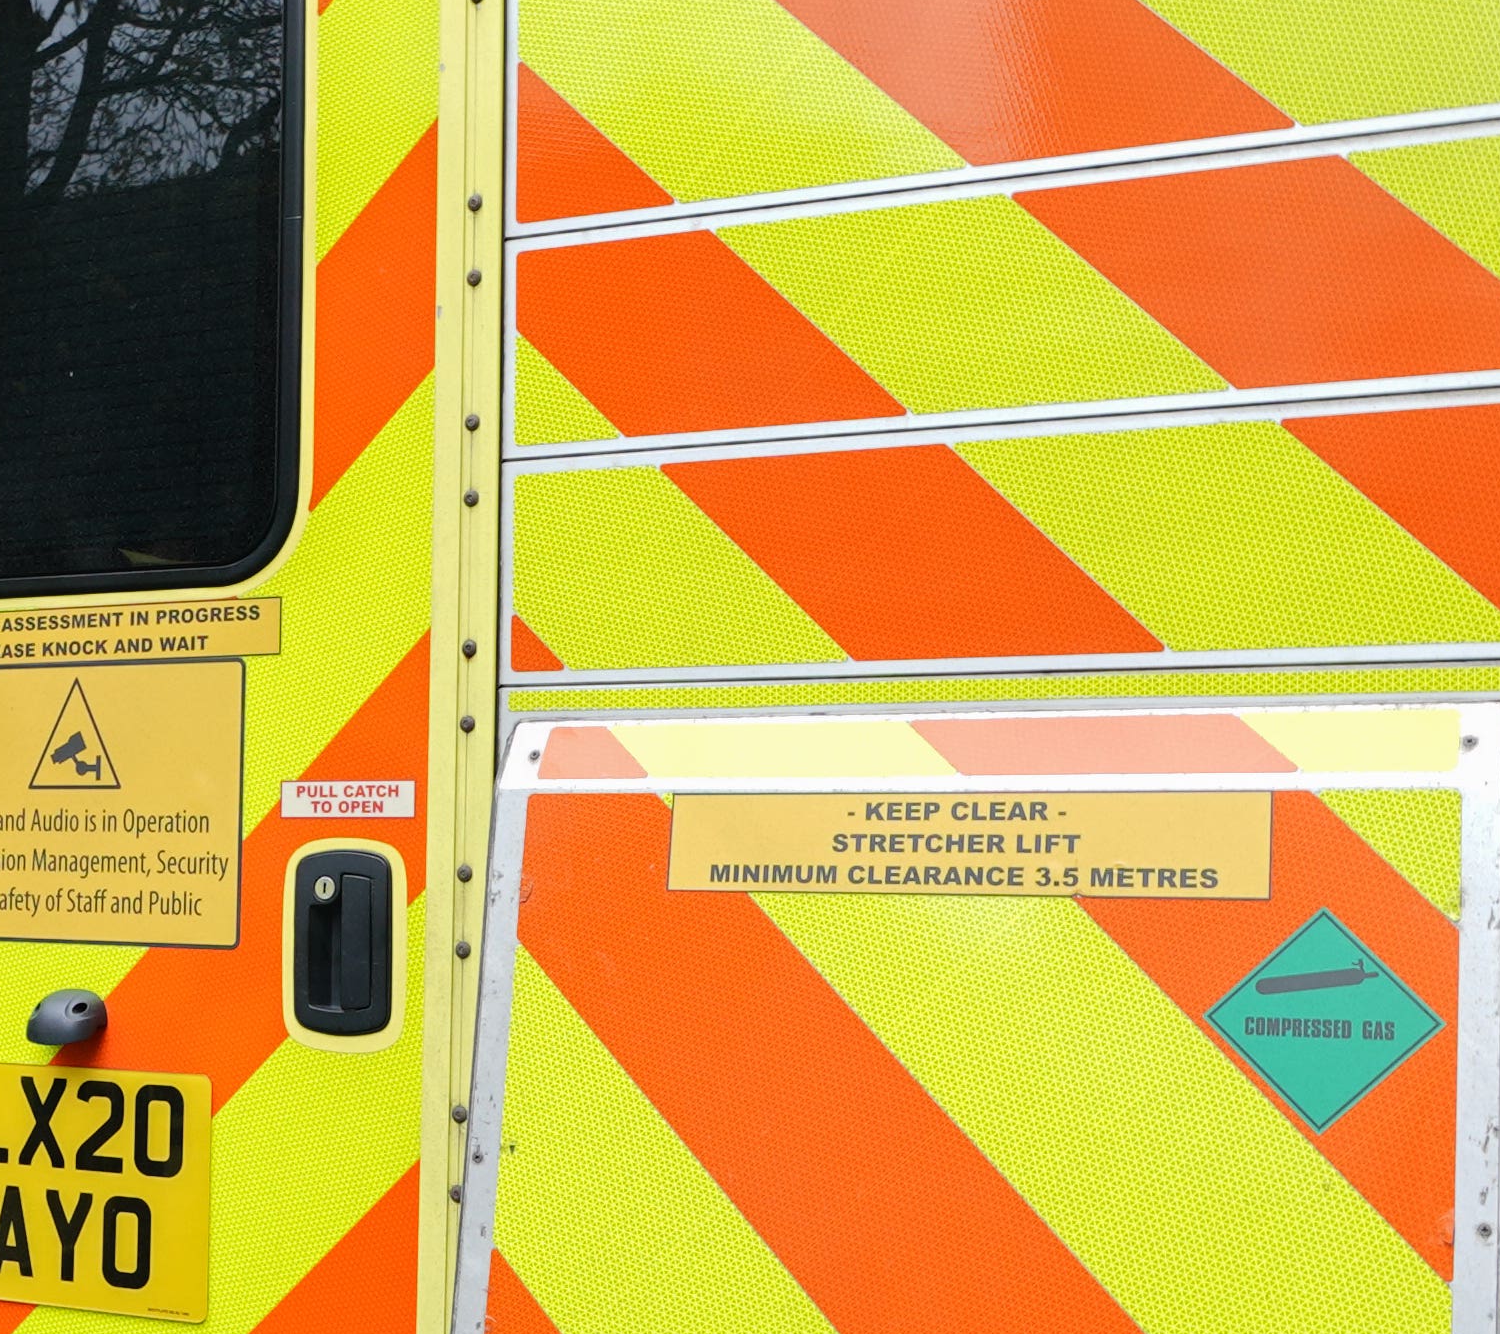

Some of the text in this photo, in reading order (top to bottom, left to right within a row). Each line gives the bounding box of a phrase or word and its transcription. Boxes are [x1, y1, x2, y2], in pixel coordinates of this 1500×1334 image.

[1, 612, 123, 633] ASSESSMENT
[130, 610, 149, 627] IN
[156, 605, 261, 625] PROGRESS
[42, 639, 108, 657] KNOCK
[114, 637, 152, 654] AND
[160, 634, 209, 652] WAIT
[296, 785, 400, 798] PULL CATCH
[311, 800, 384, 813] TO OPEN
[865, 802, 941, 821] KEEP
[951, 801, 1049, 821] CLEAR
[31, 808, 79, 833] Audio
[84, 810, 97, 833] is
[102, 810, 118, 833] in
[123, 809, 210, 838] Operation
[832, 833, 1081, 854] STRETCHER LIFT
[32, 848, 151, 879] Management,
[157, 849, 229, 881] Security
[710, 864, 1219, 889] MINIMUM CLEARANCE 3.5 METRES
[45, 888, 64, 912] of
[66, 888, 107, 913] Staff
[110, 890, 143, 914] and
[149, 891, 202, 916] Public
[1244, 1016, 1396, 1040] COMPRESSED GAS
